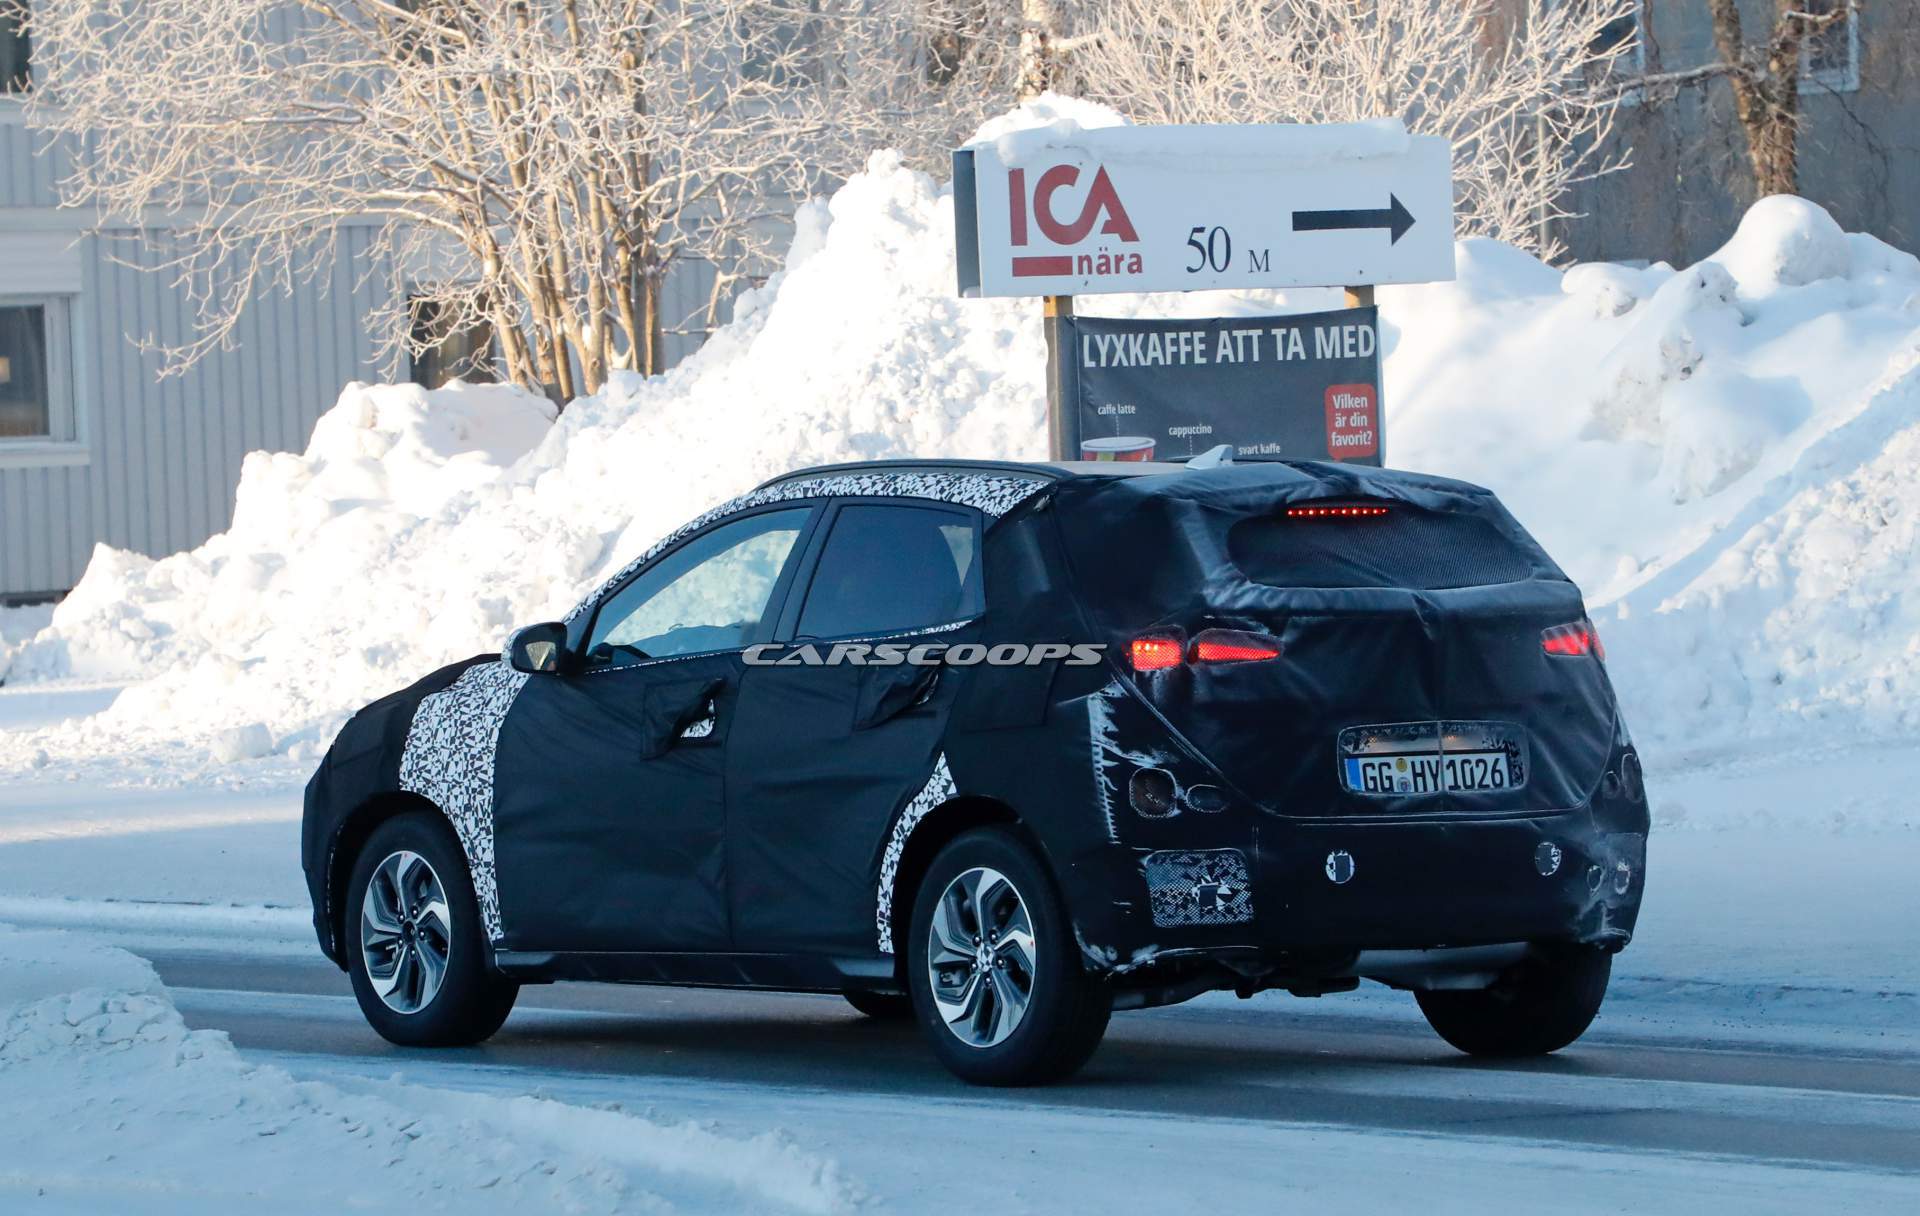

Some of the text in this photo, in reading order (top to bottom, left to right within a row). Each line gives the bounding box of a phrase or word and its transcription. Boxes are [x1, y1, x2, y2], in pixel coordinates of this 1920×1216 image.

[1008, 163, 1140, 246] ICA
[1185, 225, 1271, 274] 50 M
[1077, 246, 1144, 276] nära
[1082, 324, 1376, 368] LYXKAFFE ATT TA MED
[1117, 403, 1136, 415] latte
[1332, 393, 1368, 409] Vilken
[1335, 411, 1368, 428] är din
[1168, 423, 1213, 439] cappuccino
[1331, 430, 1373, 447] favorit?
[1238, 443, 1281, 456] svart kaffe
[1362, 761, 1395, 793] GG
